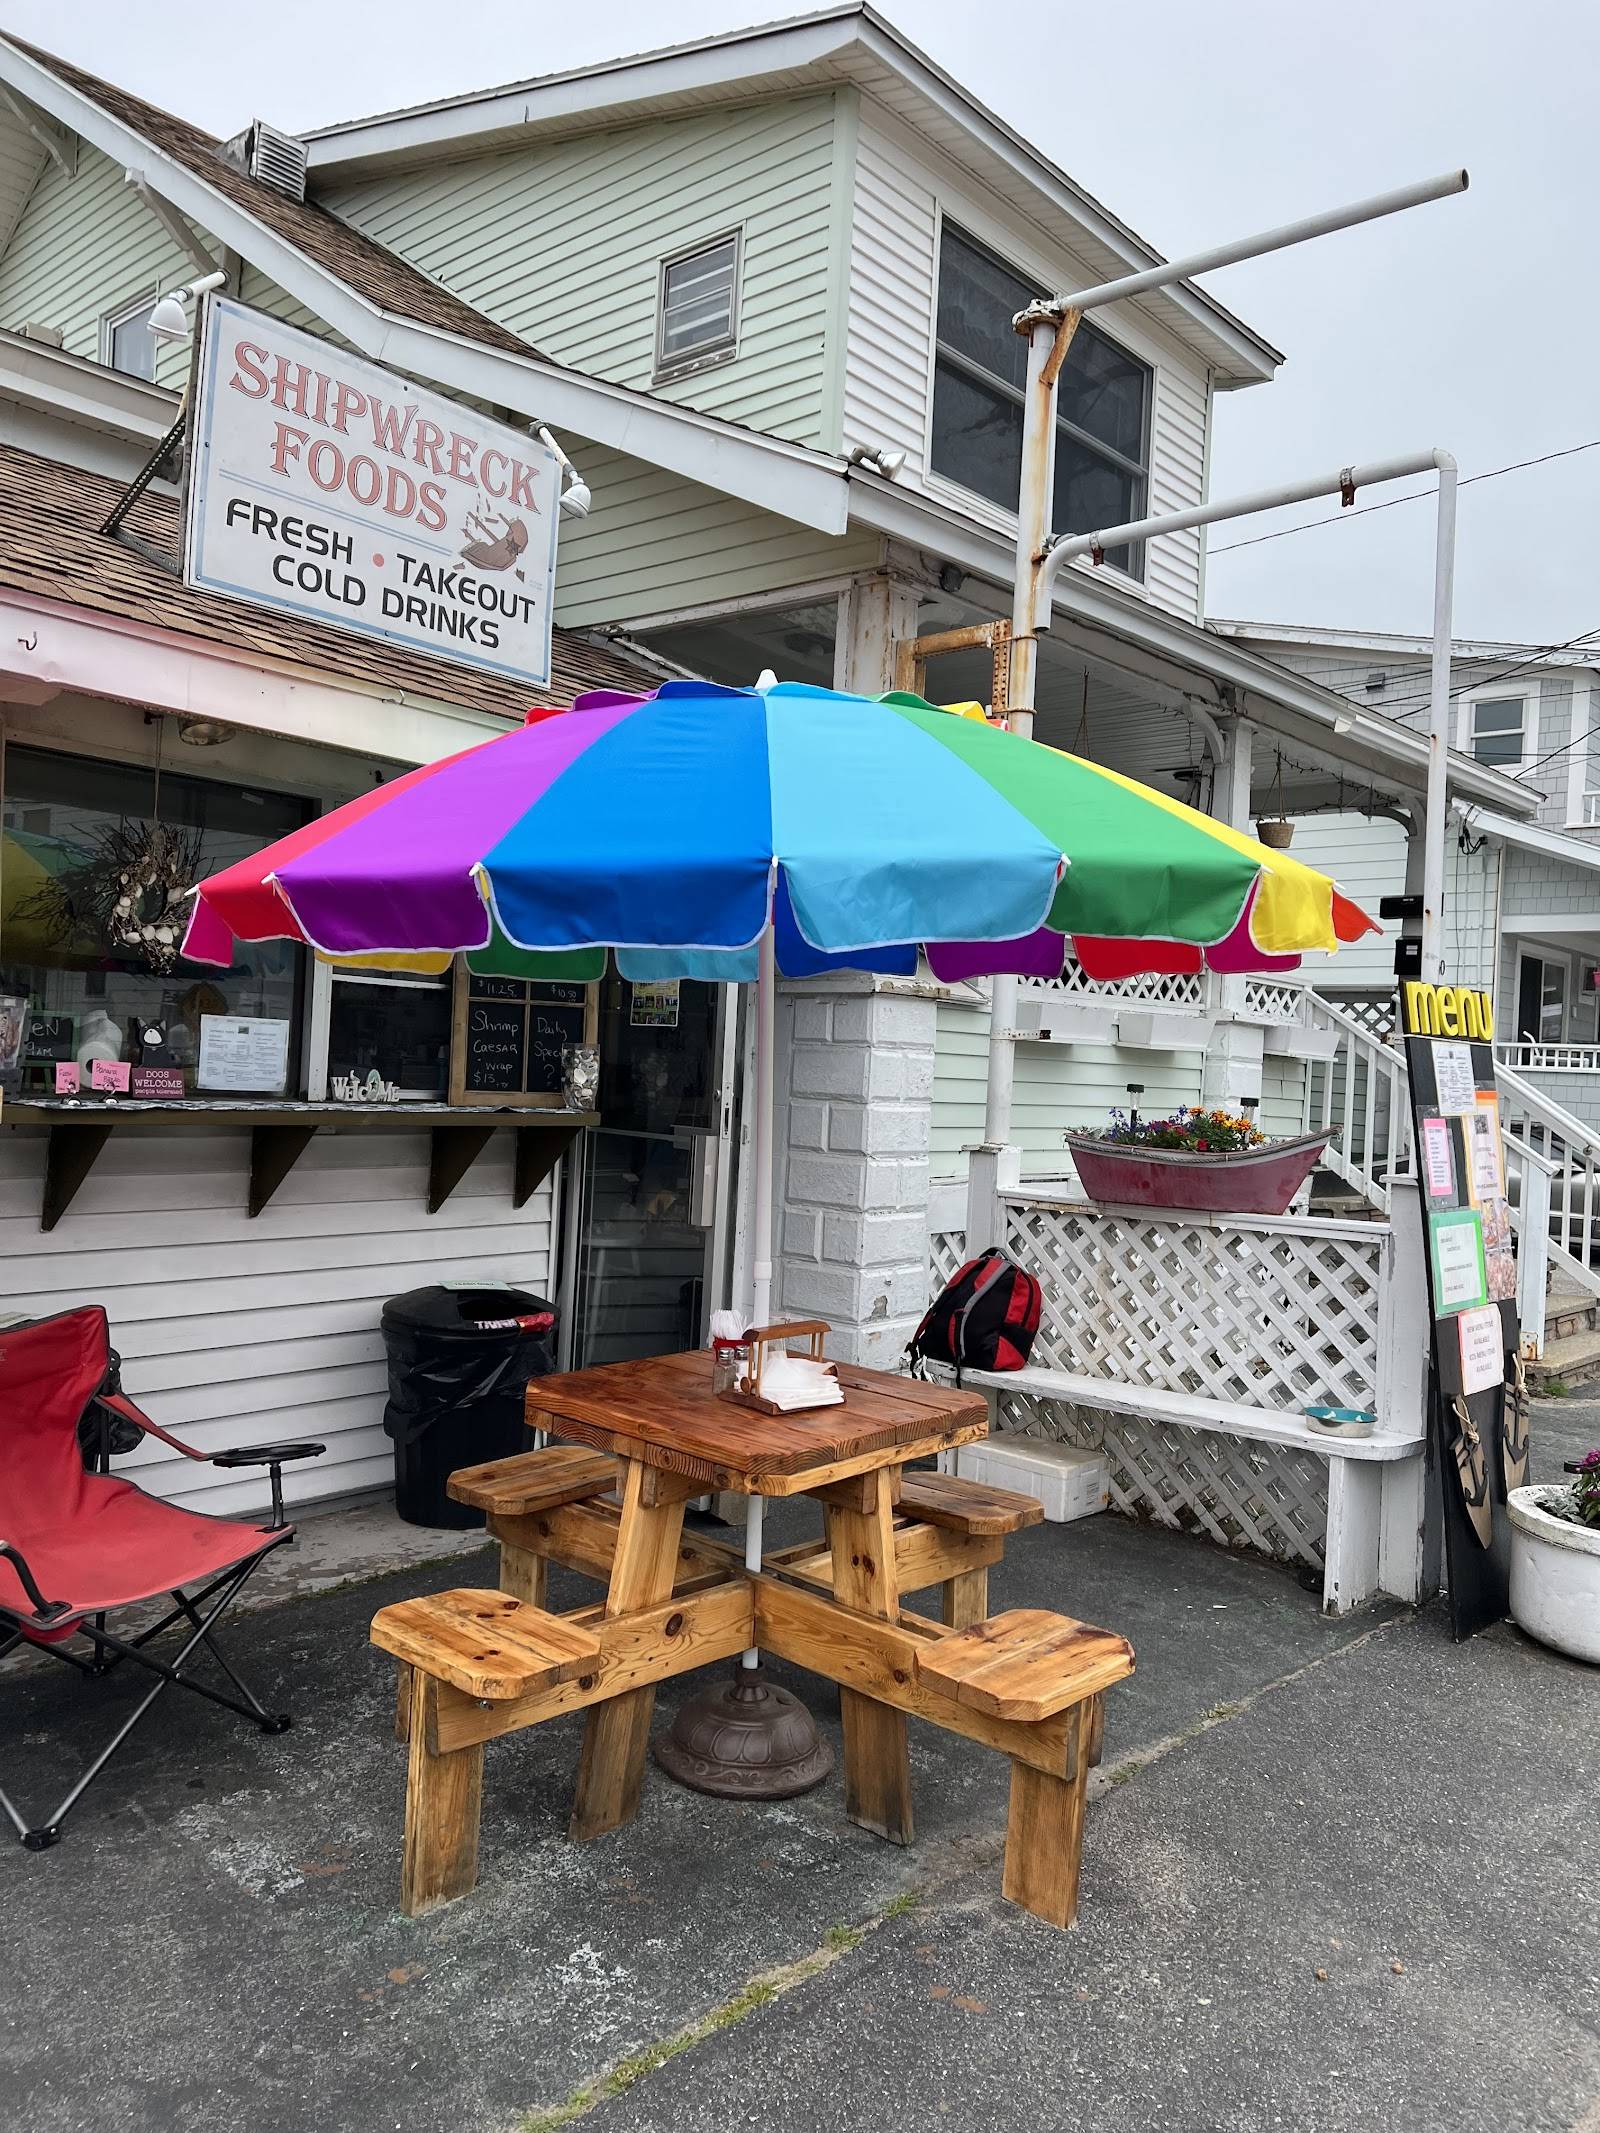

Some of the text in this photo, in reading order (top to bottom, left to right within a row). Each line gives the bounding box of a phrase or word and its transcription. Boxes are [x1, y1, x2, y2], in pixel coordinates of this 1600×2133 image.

[229, 341, 541, 514] SHIPWRECK
[270, 421, 448, 531] FOODS
[226, 498, 535, 624] FRESH TAKEOUT
[273, 555, 499, 649] COLD DRINKS
[471, 1010, 519, 1037] Shrimp
[537, 1017, 568, 1041] Daily
[1406, 981, 1494, 1041] menu
[134, 1079, 182, 1088] WELCOME
[145, 1070, 169, 1078] DOGS
[330, 1069, 401, 1102] WELCOME
